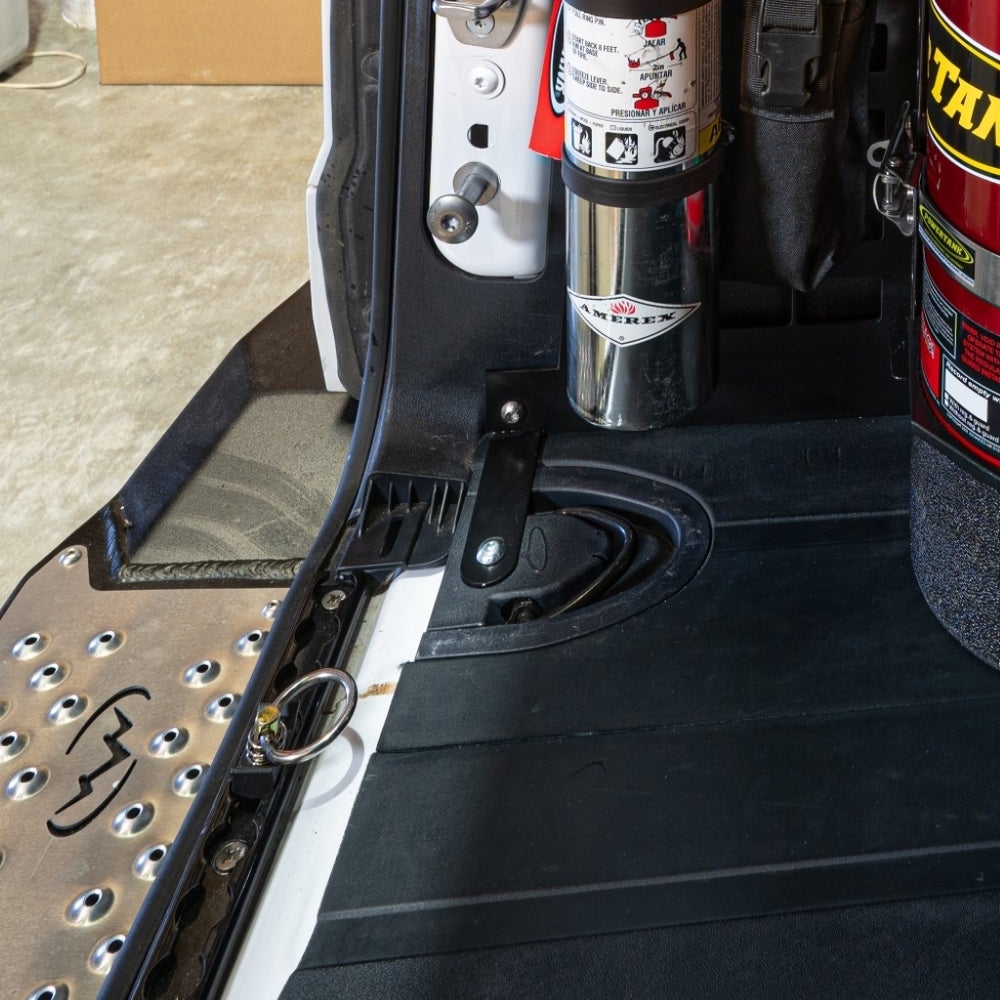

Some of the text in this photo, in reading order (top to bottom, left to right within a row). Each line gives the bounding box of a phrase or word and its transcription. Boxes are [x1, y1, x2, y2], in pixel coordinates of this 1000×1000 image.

[584, 40, 598, 51] BACK
[639, 69, 673, 81] APUNTAR
[598, 84, 606, 92] TO
[610, 107, 651, 118] PRESIONAR
[651, 108, 657, 116] Y
[579, 303, 677, 326] AMEREX
[967, 381, 992, 399] empty
[972, 416, 990, 432] guard
[981, 430, 1000, 444] guard
